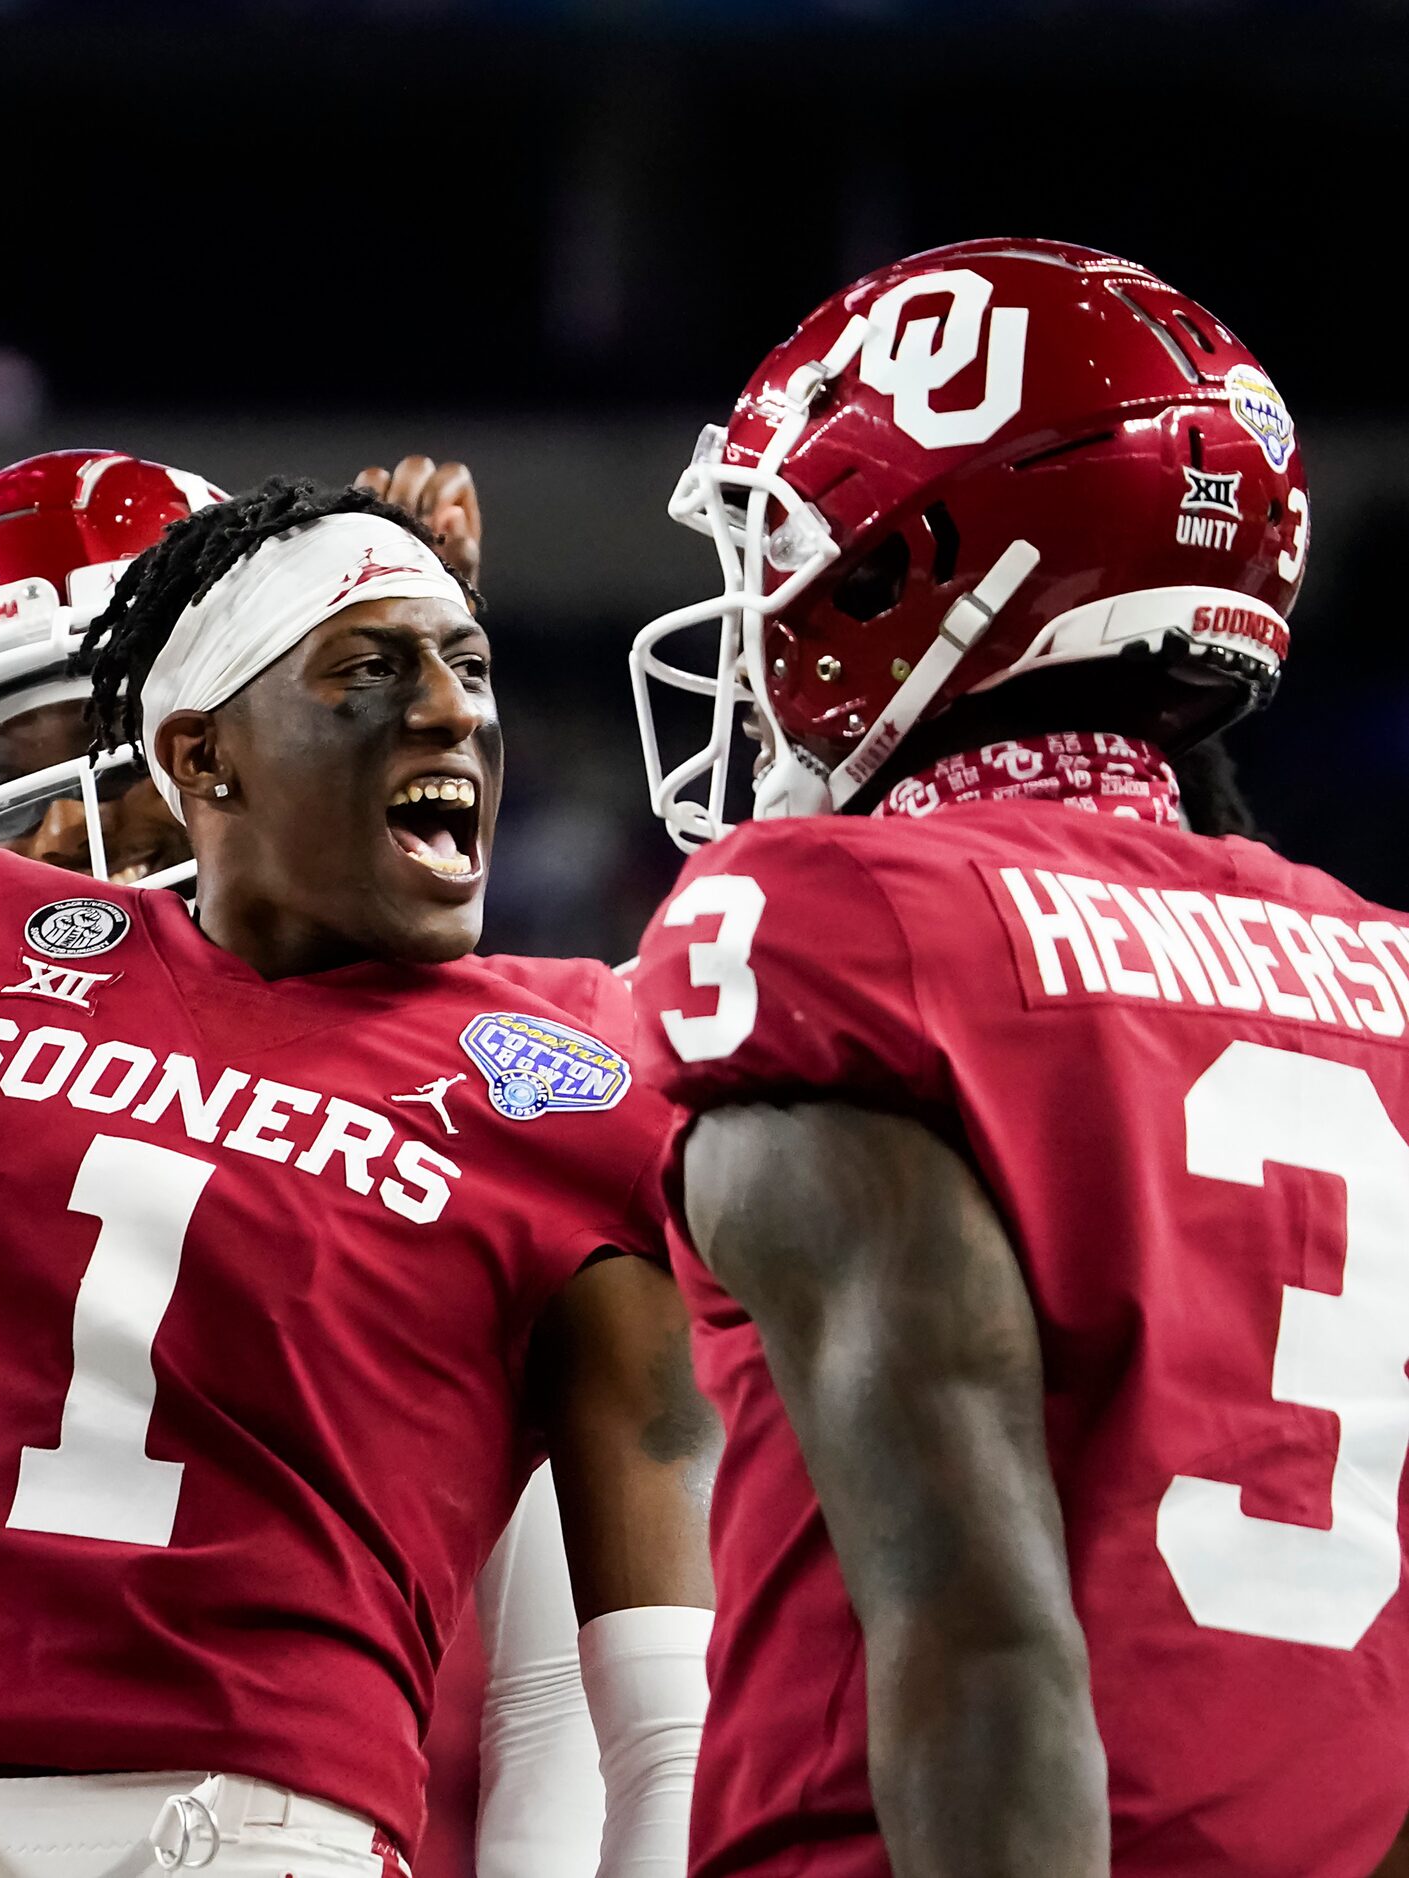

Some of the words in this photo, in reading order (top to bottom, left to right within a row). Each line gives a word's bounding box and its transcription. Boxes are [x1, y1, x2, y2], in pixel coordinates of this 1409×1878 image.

[859, 269, 1029, 449] OU
[1188, 474, 1234, 508] XII
[1176, 514, 1239, 551] UNITY
[1278, 487, 1309, 584] 3
[1193, 606, 1291, 661] SOONER
[0, 955, 114, 1009] XII
[659, 873, 767, 1063] 3
[999, 867, 1409, 1038] HENDERSO
[477, 1024, 617, 1097] COTTON
[494, 1047, 578, 1096] BOWL
[496, 1015, 621, 1070] GOODYEAR
[5, 1134, 217, 1547] 1
[1156, 1040, 1409, 1651] 3
